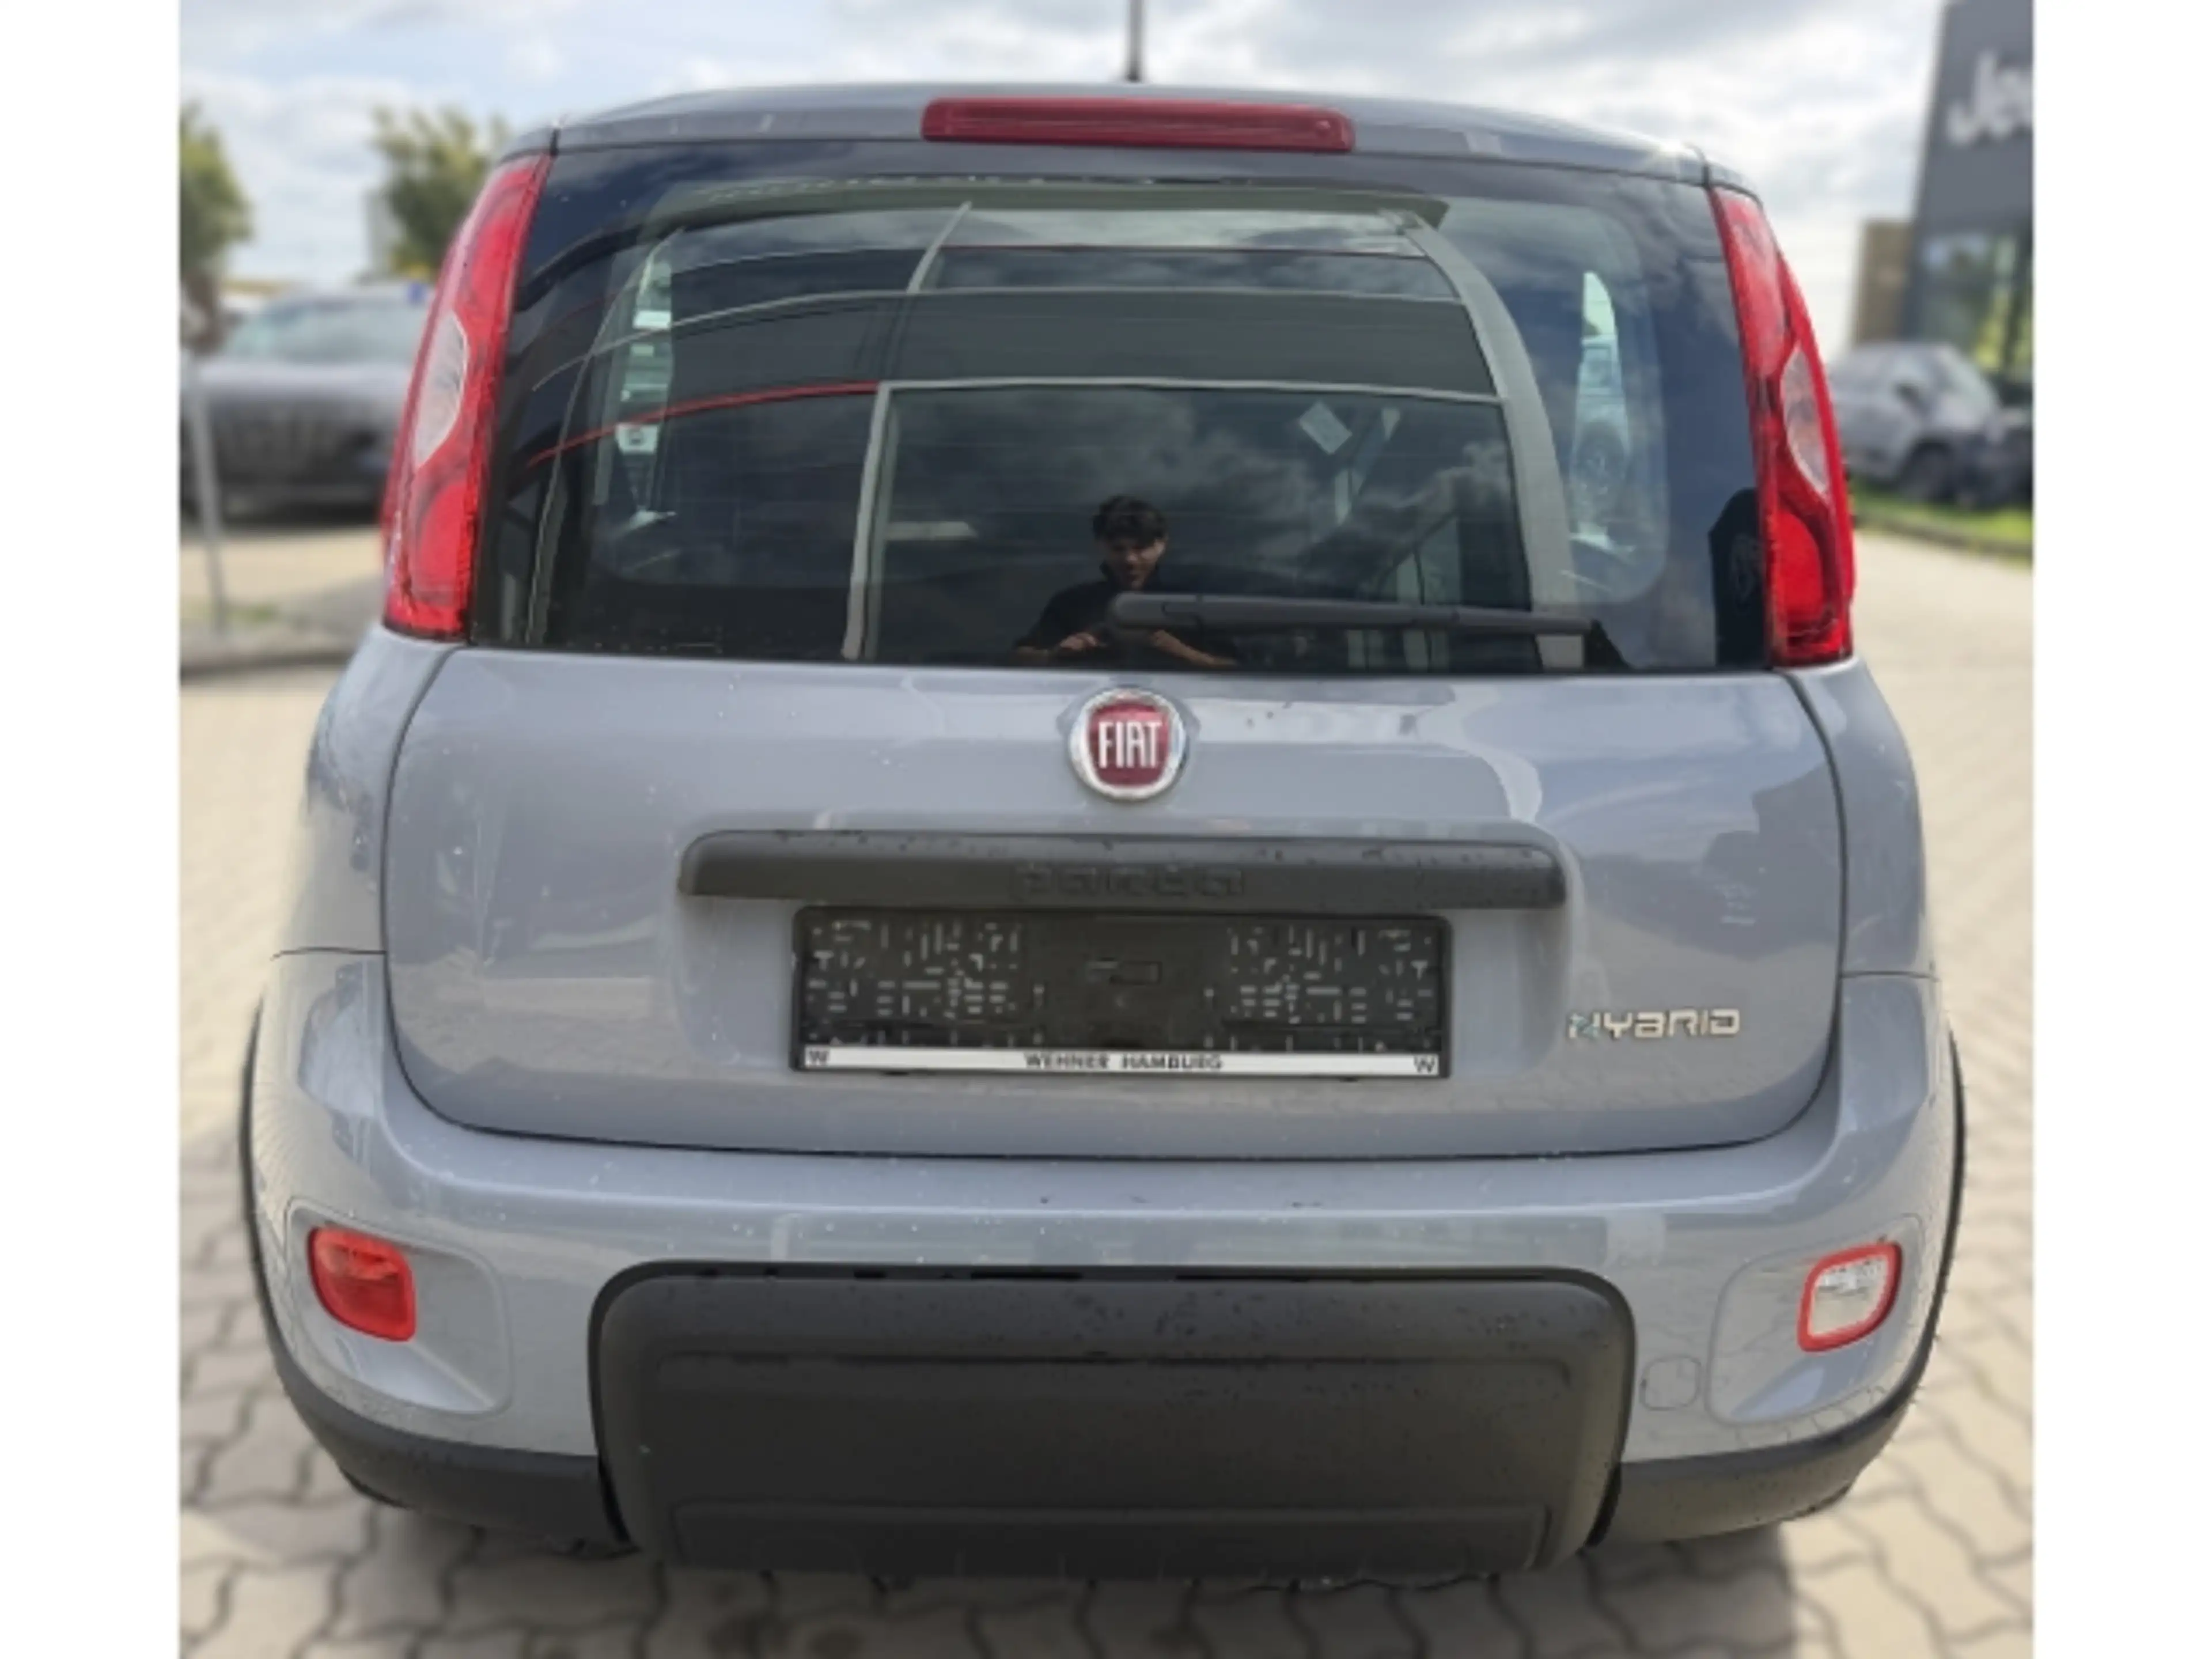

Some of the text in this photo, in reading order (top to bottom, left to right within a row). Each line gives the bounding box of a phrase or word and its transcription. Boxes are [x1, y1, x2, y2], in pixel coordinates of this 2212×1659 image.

[1098, 721, 1162, 768] FIAT
[1569, 1008, 1740, 1039] HYBRID
[808, 1050, 1435, 1074] W WEHNER HAMBURG W
